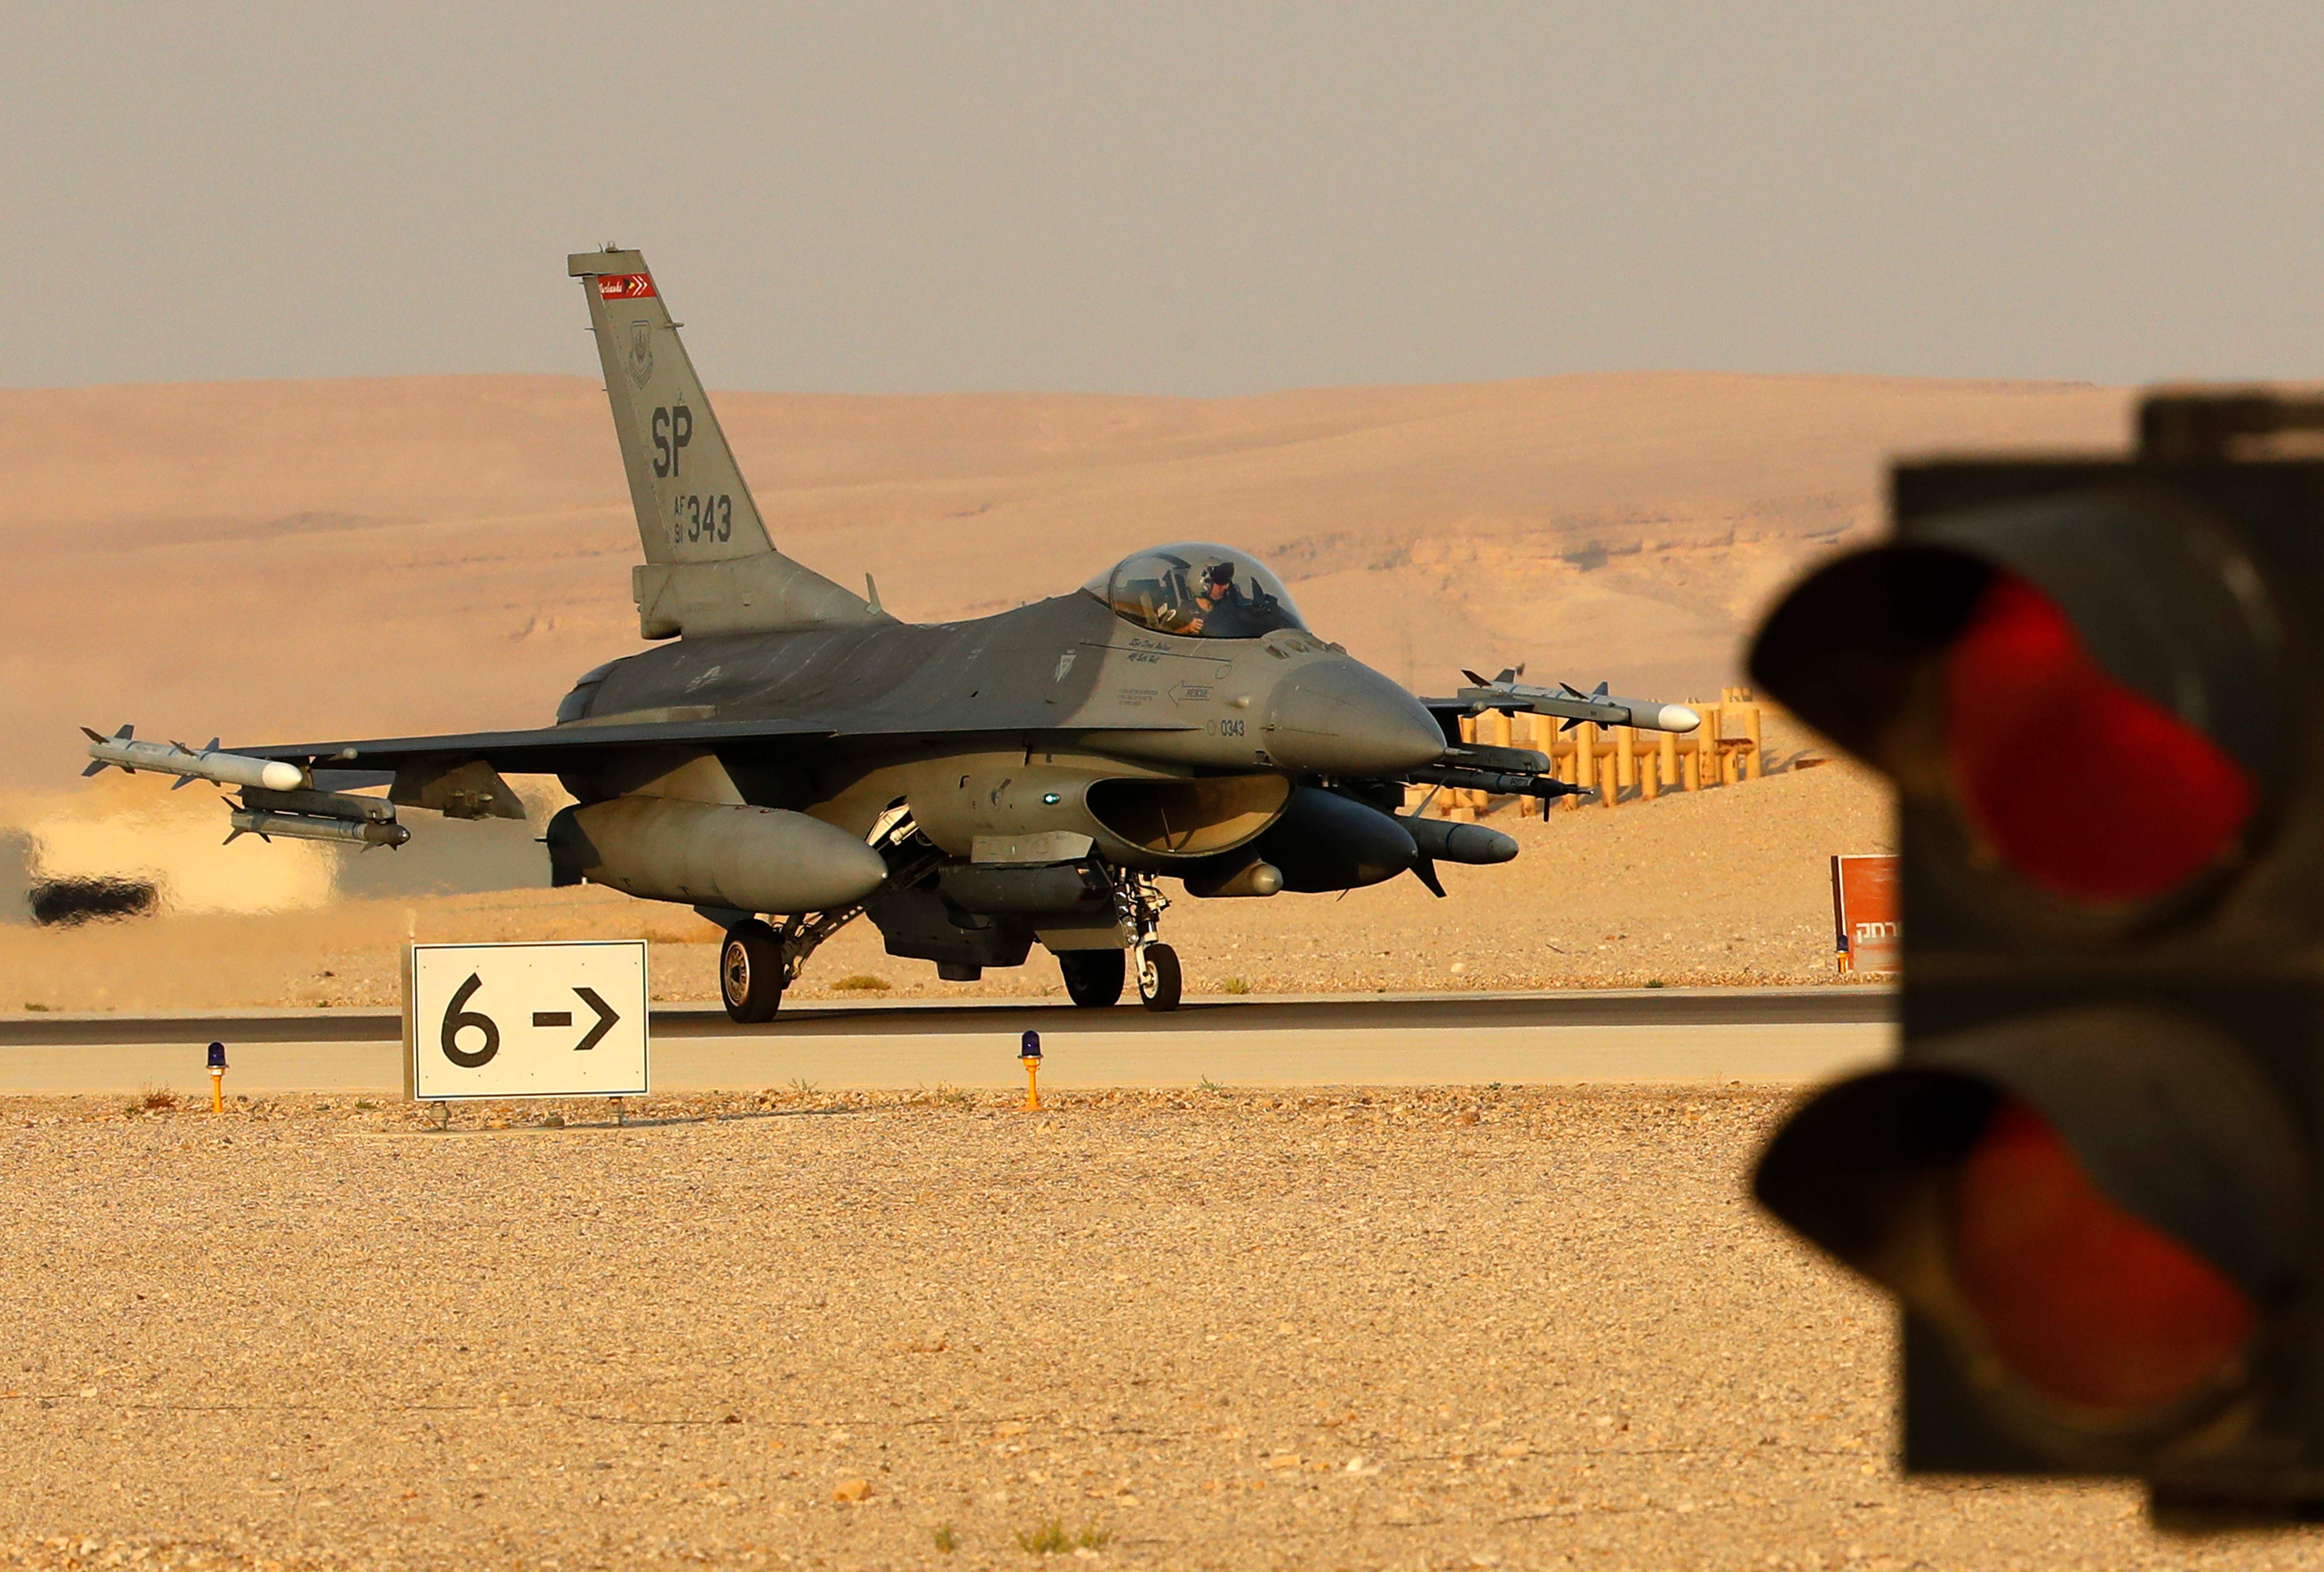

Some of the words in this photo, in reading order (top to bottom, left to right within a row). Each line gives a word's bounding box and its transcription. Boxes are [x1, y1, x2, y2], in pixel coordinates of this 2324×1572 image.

[652, 405, 693, 477] SP
[674, 496, 686, 516] AF
[687, 495, 732, 543] 343
[1221, 719, 1244, 736] 0343
[1856, 921, 1903, 943] רחק
[441, 972, 500, 1068] 6
